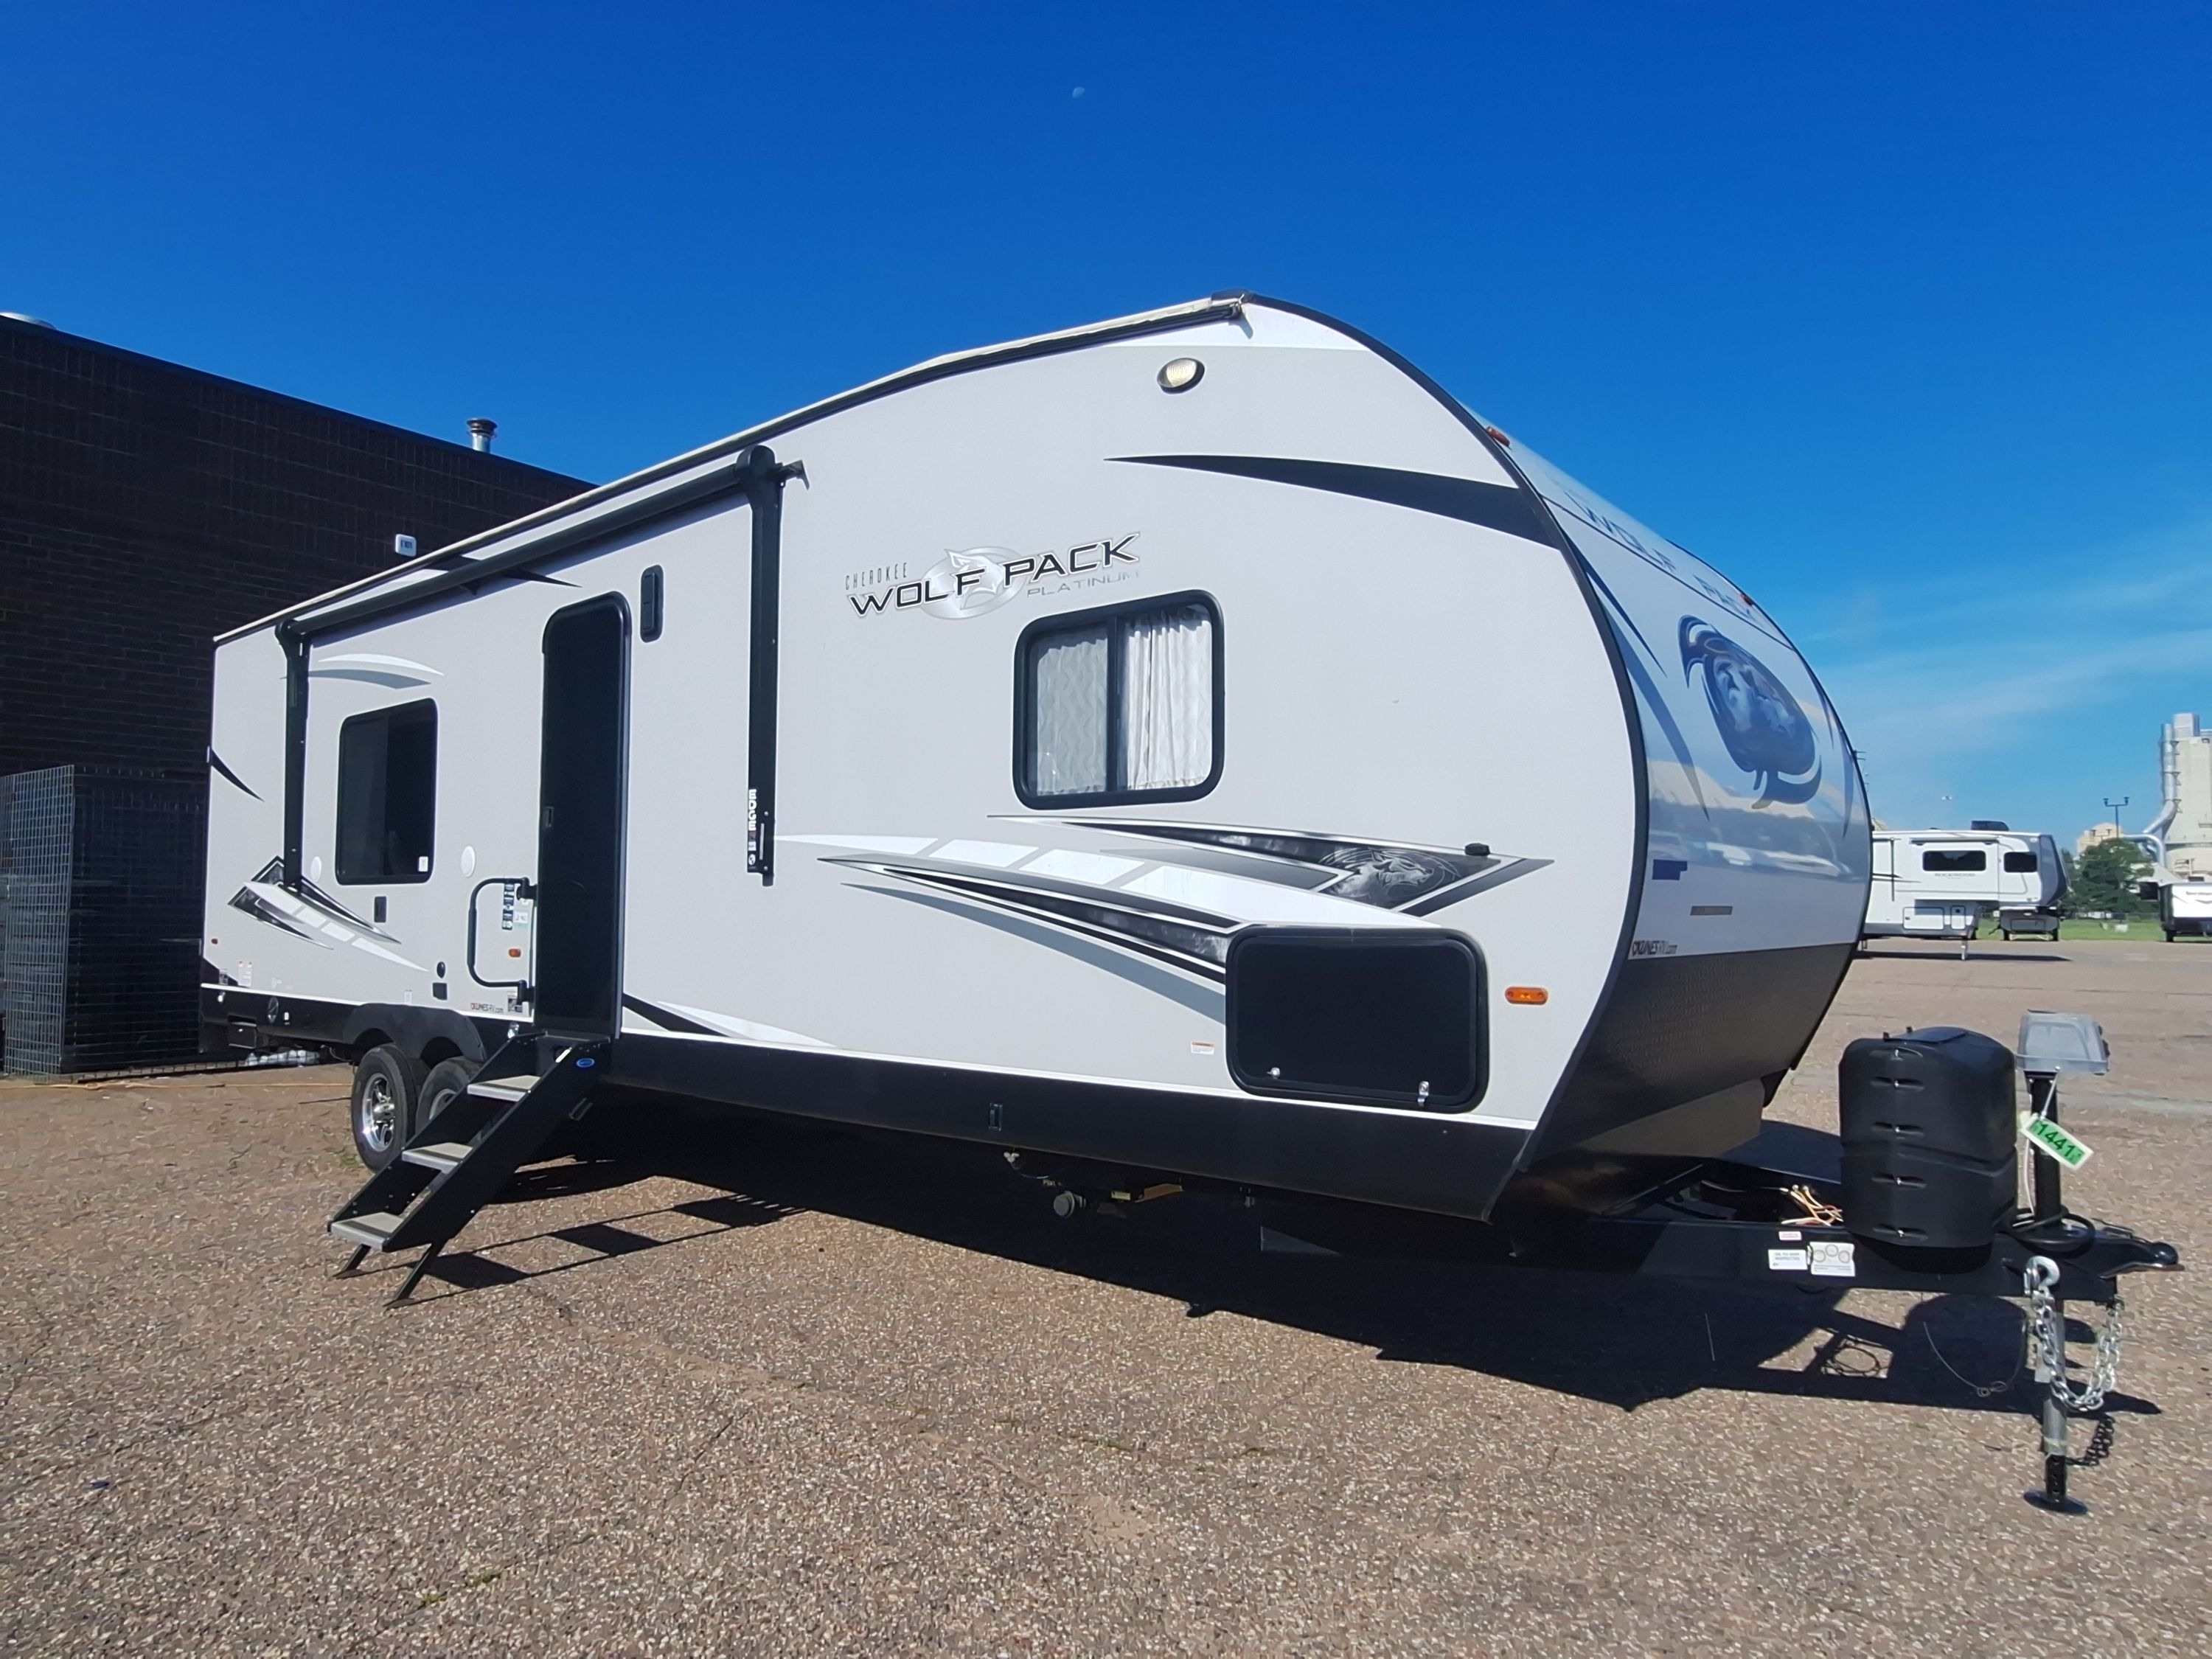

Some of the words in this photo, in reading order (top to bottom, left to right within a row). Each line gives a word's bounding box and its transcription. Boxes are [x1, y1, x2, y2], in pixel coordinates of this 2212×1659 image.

[845, 562, 908, 591] CHEROKEE
[849, 568, 987, 616] WOLF
[1004, 532, 1140, 586] PACK
[2037, 1123, 2076, 1157] 1441
